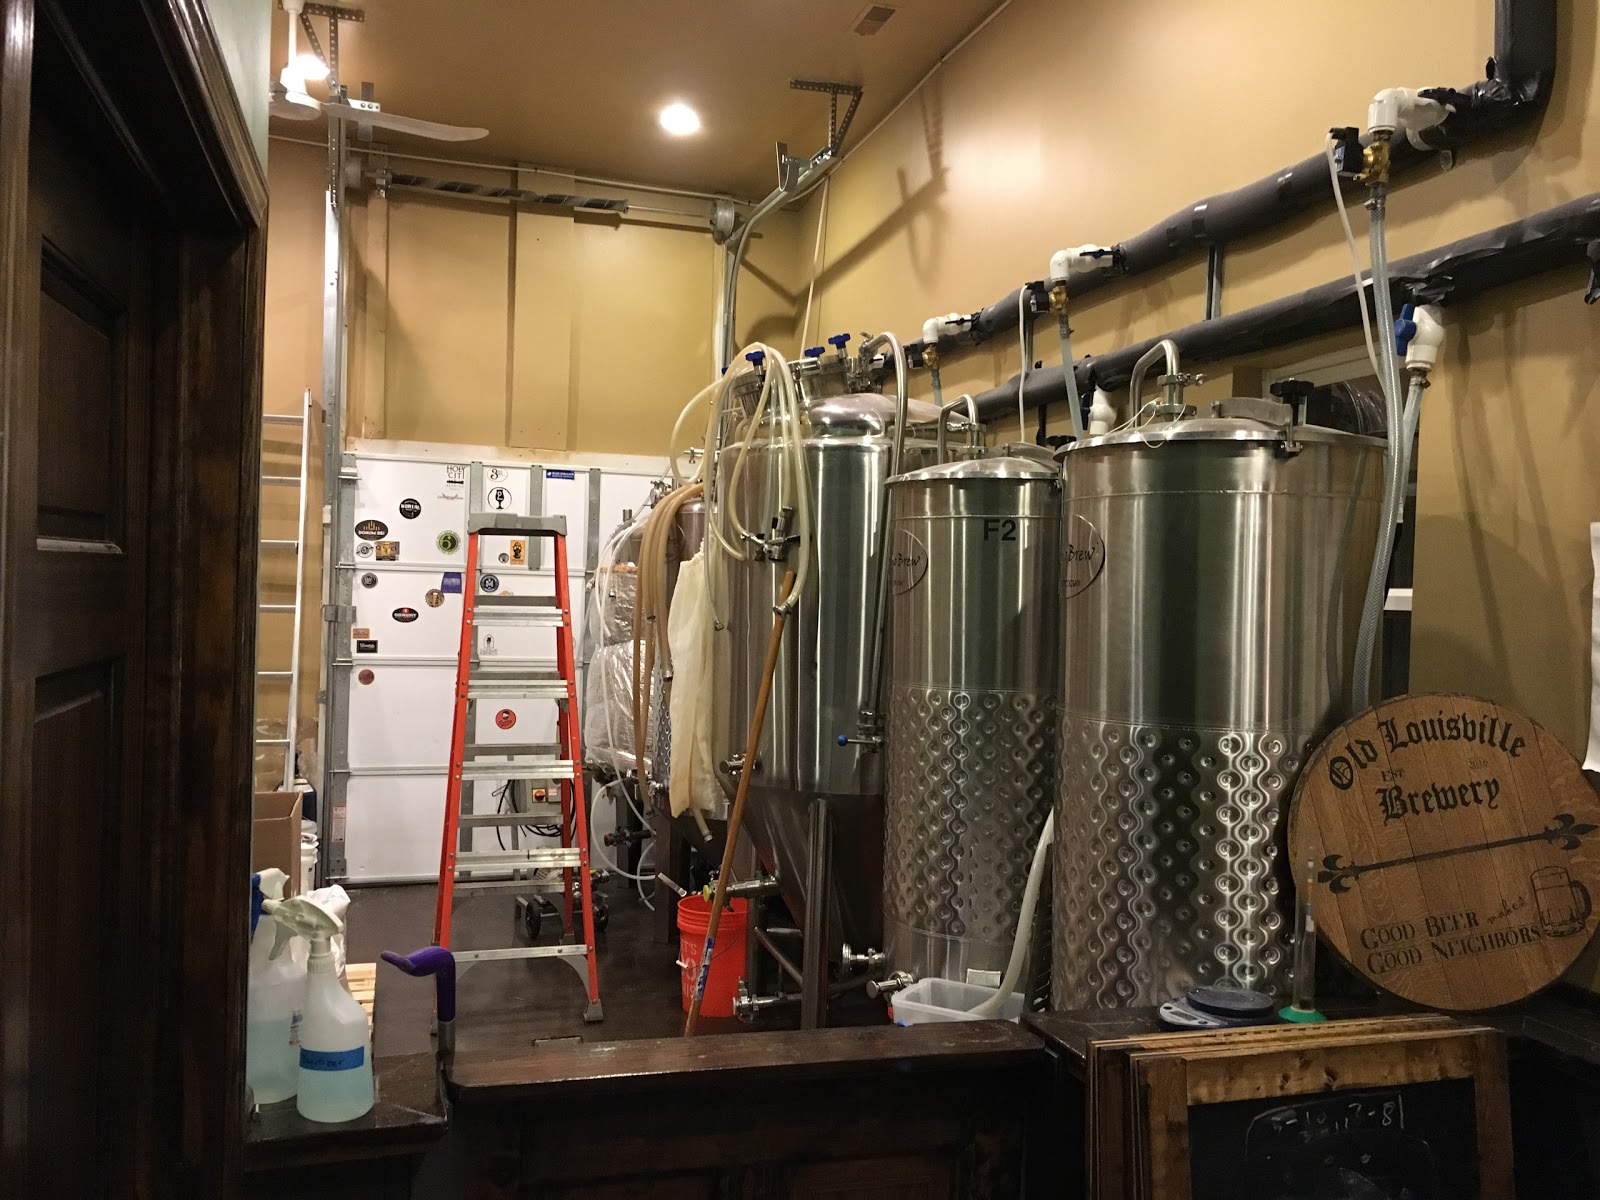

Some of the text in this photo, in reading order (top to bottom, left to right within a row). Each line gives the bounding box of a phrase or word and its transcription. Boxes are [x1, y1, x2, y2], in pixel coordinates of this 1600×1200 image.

[446, 465, 466, 475] HOLY
[490, 468, 499, 480] 3
[983, 518, 1017, 541] F2
[485, 579, 494, 588] M
[1328, 710, 1526, 790] Old Louisville
[1468, 757, 1489, 769] 2016
[1375, 777, 1500, 826] Brewery
[1360, 923, 1416, 951] GOOD
[1424, 910, 1480, 938] BEER
[1366, 924, 1542, 975] GOOD NEIGHBORS
